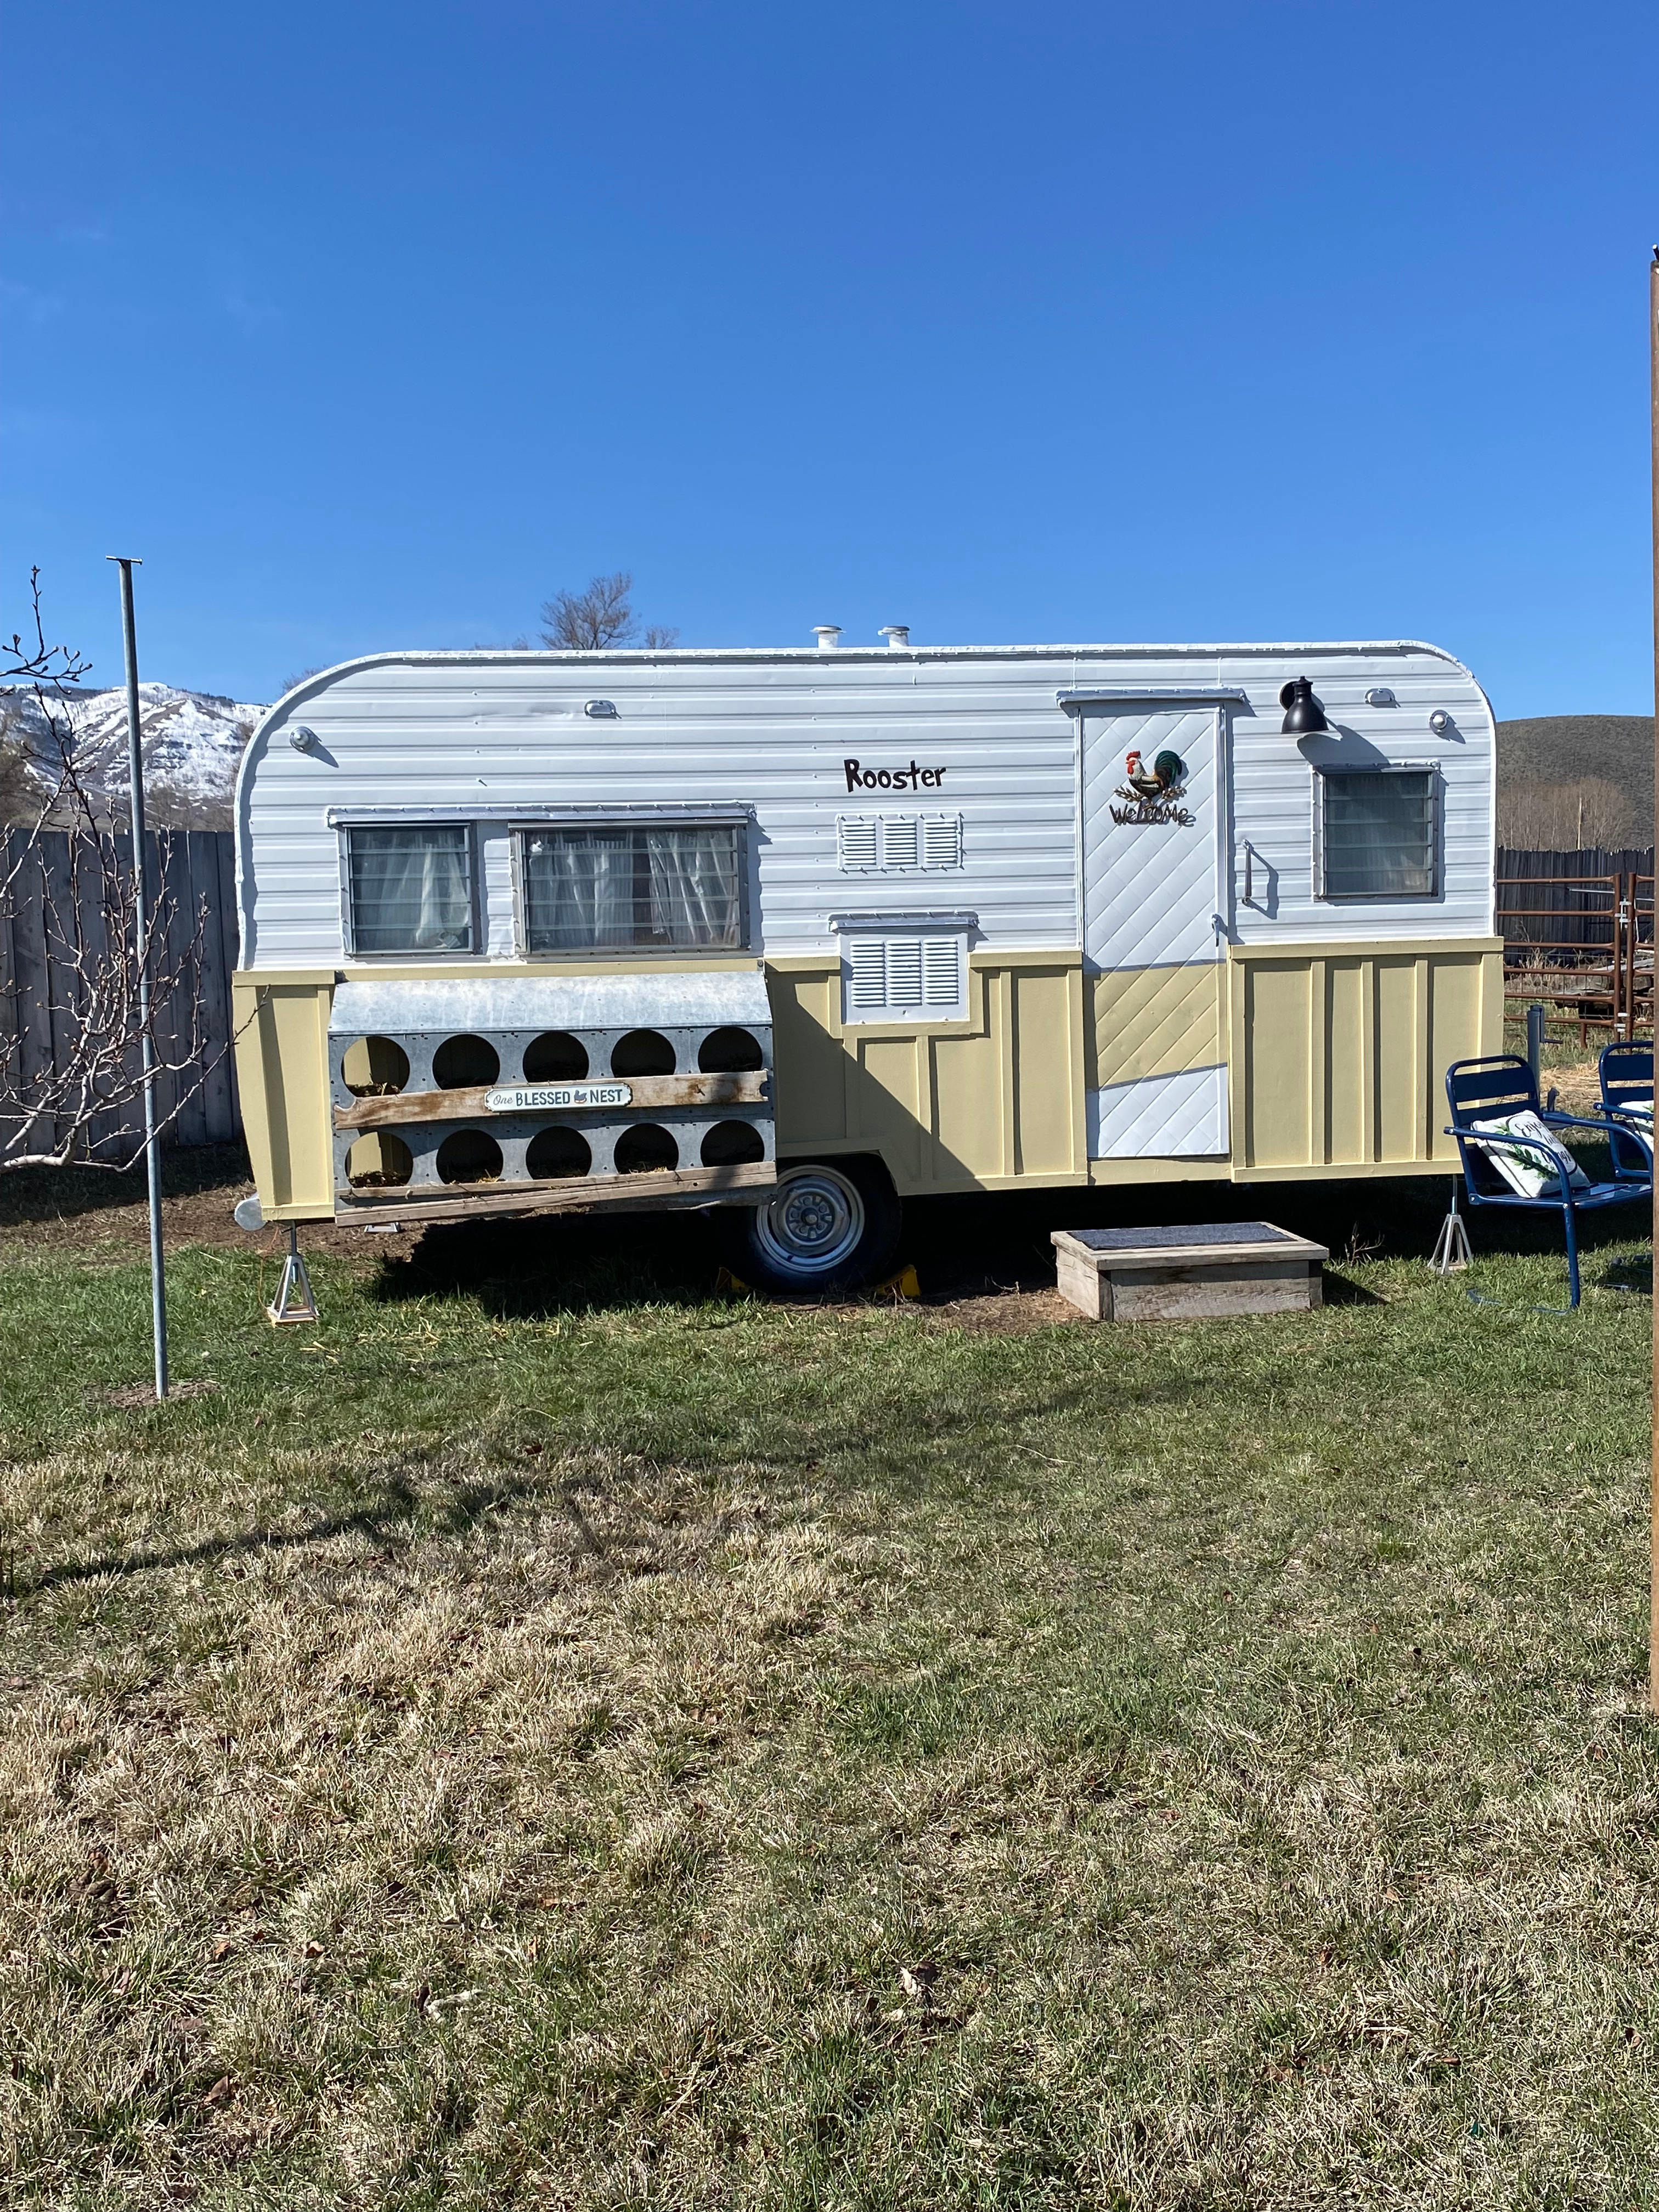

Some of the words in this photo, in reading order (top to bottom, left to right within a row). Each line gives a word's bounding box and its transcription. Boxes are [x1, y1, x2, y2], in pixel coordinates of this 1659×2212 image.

[844, 759, 946, 793] Rooster
[493, 1095, 513, 1105] One
[516, 1091, 571, 1107] BLESSED
[590, 1089, 623, 1103] NEST
